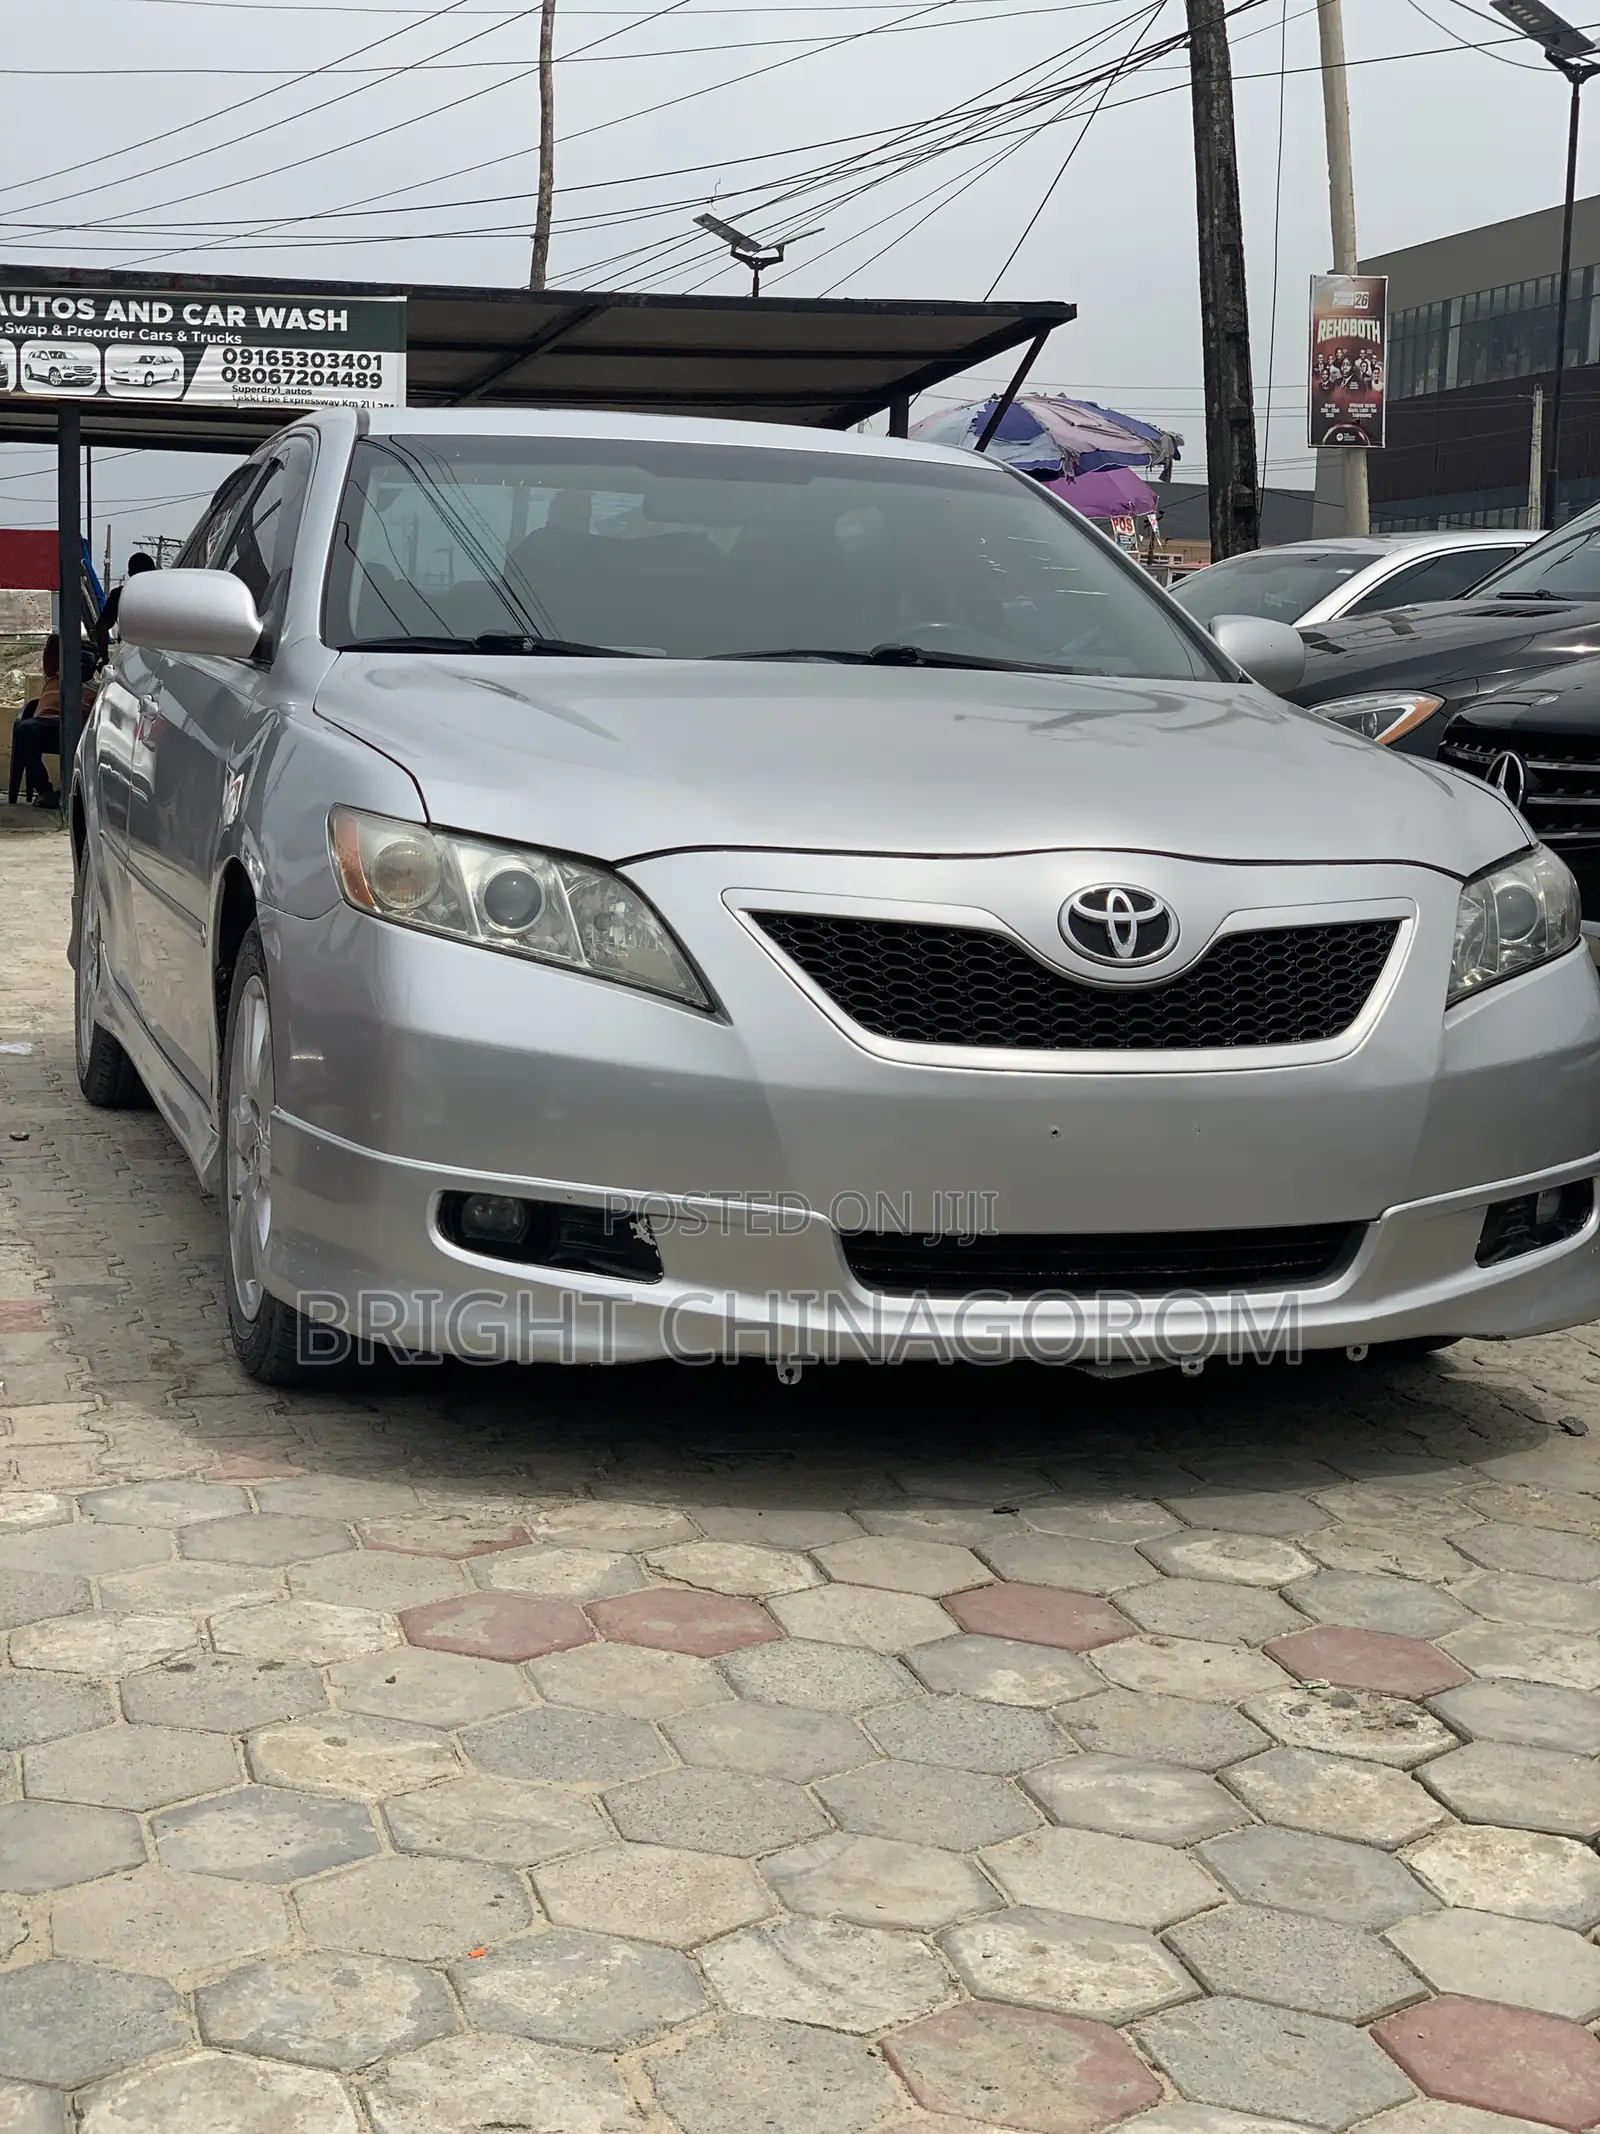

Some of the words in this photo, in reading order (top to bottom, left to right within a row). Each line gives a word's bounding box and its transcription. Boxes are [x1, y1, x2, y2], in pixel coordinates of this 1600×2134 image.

[1355, 293, 1369, 307] 26
[104, 299, 173, 324] AND
[182, 303, 247, 327] CAR
[254, 306, 348, 332] WASH
[4, 322, 47, 338] Swap
[51, 324, 62, 336] &
[67, 325, 135, 339] Preorder
[138, 328, 173, 342] Cars
[176, 330, 188, 342] &
[190, 331, 242, 344] Trucks
[1316, 318, 1381, 344] REHOBOTH
[222, 347, 382, 371] 09165303401
[221, 366, 383, 389] 08067204489
[262, 395, 281, 404] Epe
[342, 399, 358, 408] Km
[1112, 517, 1133, 532] POS
